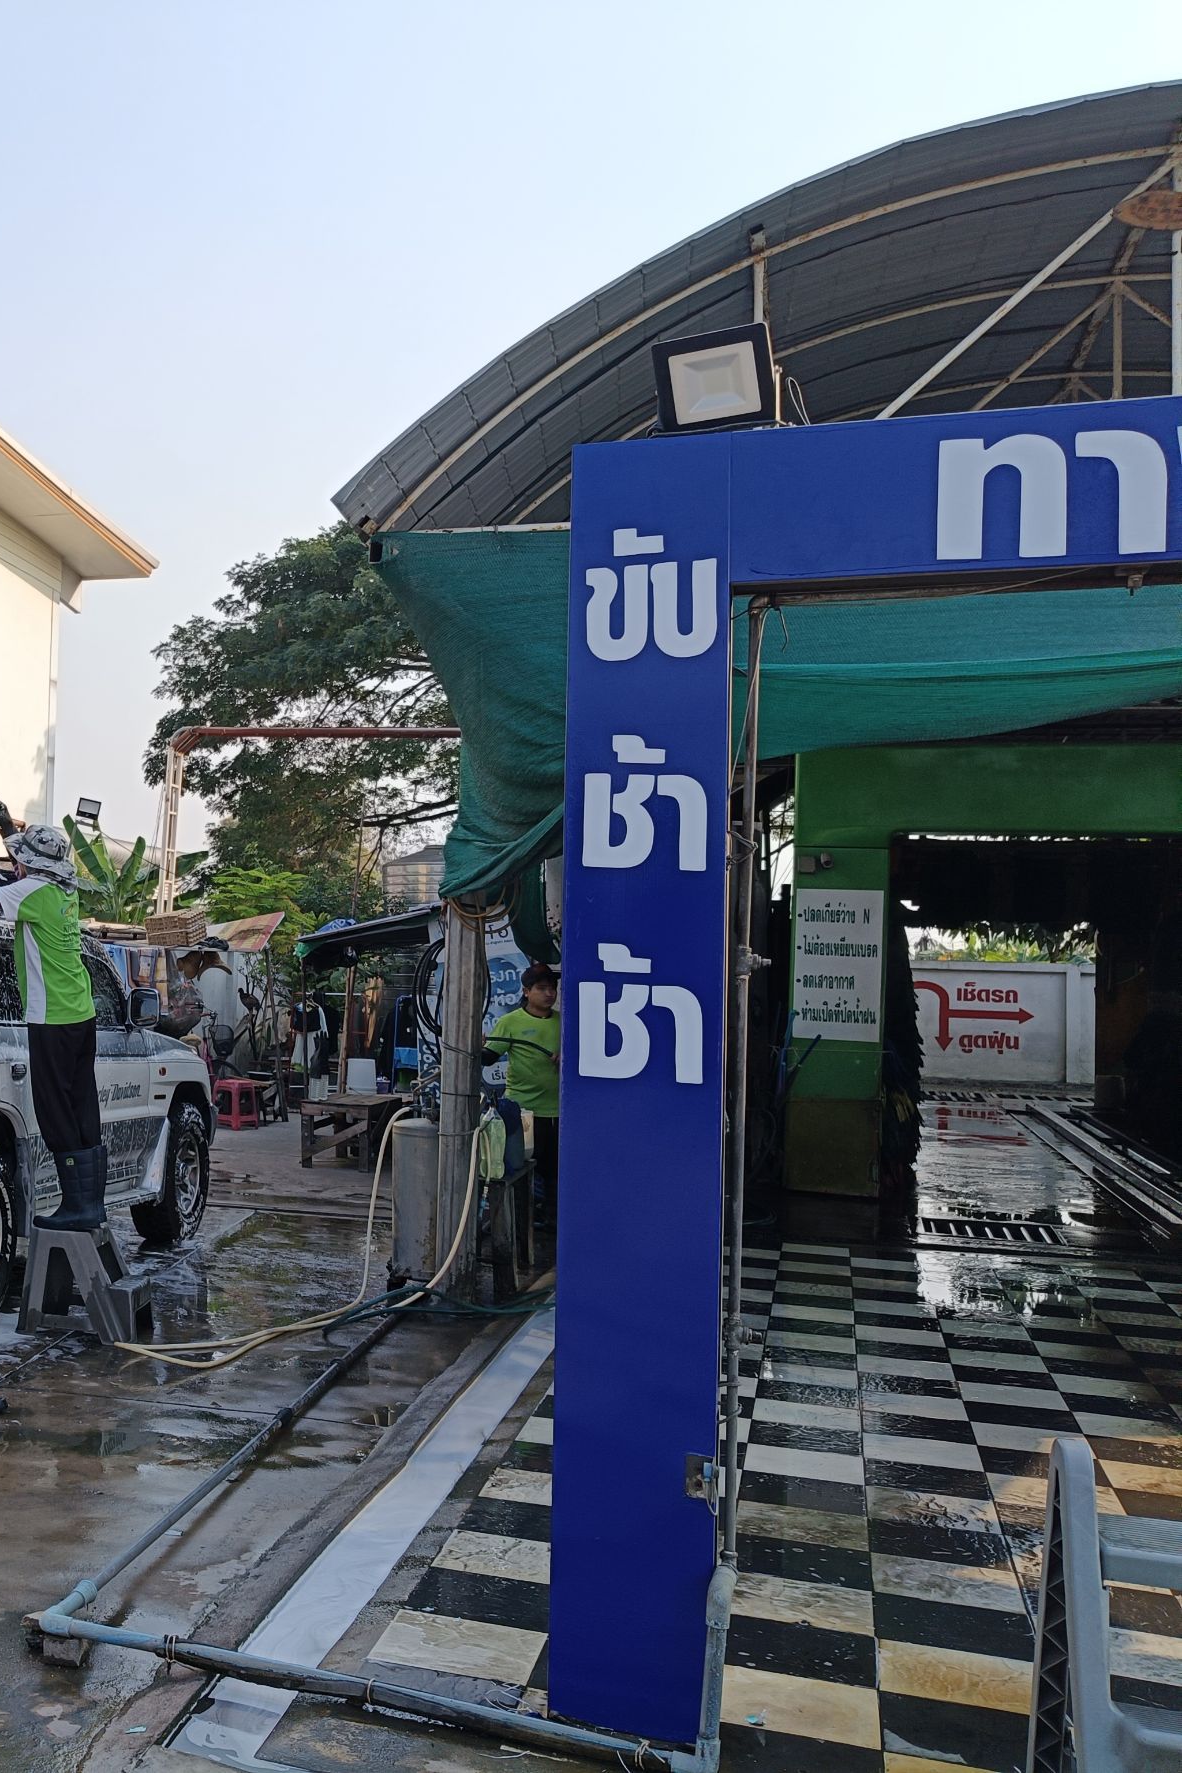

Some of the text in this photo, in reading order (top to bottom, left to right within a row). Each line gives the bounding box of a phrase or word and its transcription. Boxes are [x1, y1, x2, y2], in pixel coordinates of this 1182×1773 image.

[936, 430, 1182, 561] ทา
[586, 528, 718, 662] ขับ
[582, 734, 708, 872] ช้า
[803, 902, 870, 924] ปลดเกียร์ว่าง N
[803, 934, 878, 957] ไม่ต้องเหยียบเบรค
[802, 974, 855, 990] ลดเสาอากาศ
[956, 981, 1019, 1004] เช็ดรถ
[578, 943, 704, 1085] ช้า
[958, 1030, 1020, 1055] ดูดฝุ่น
